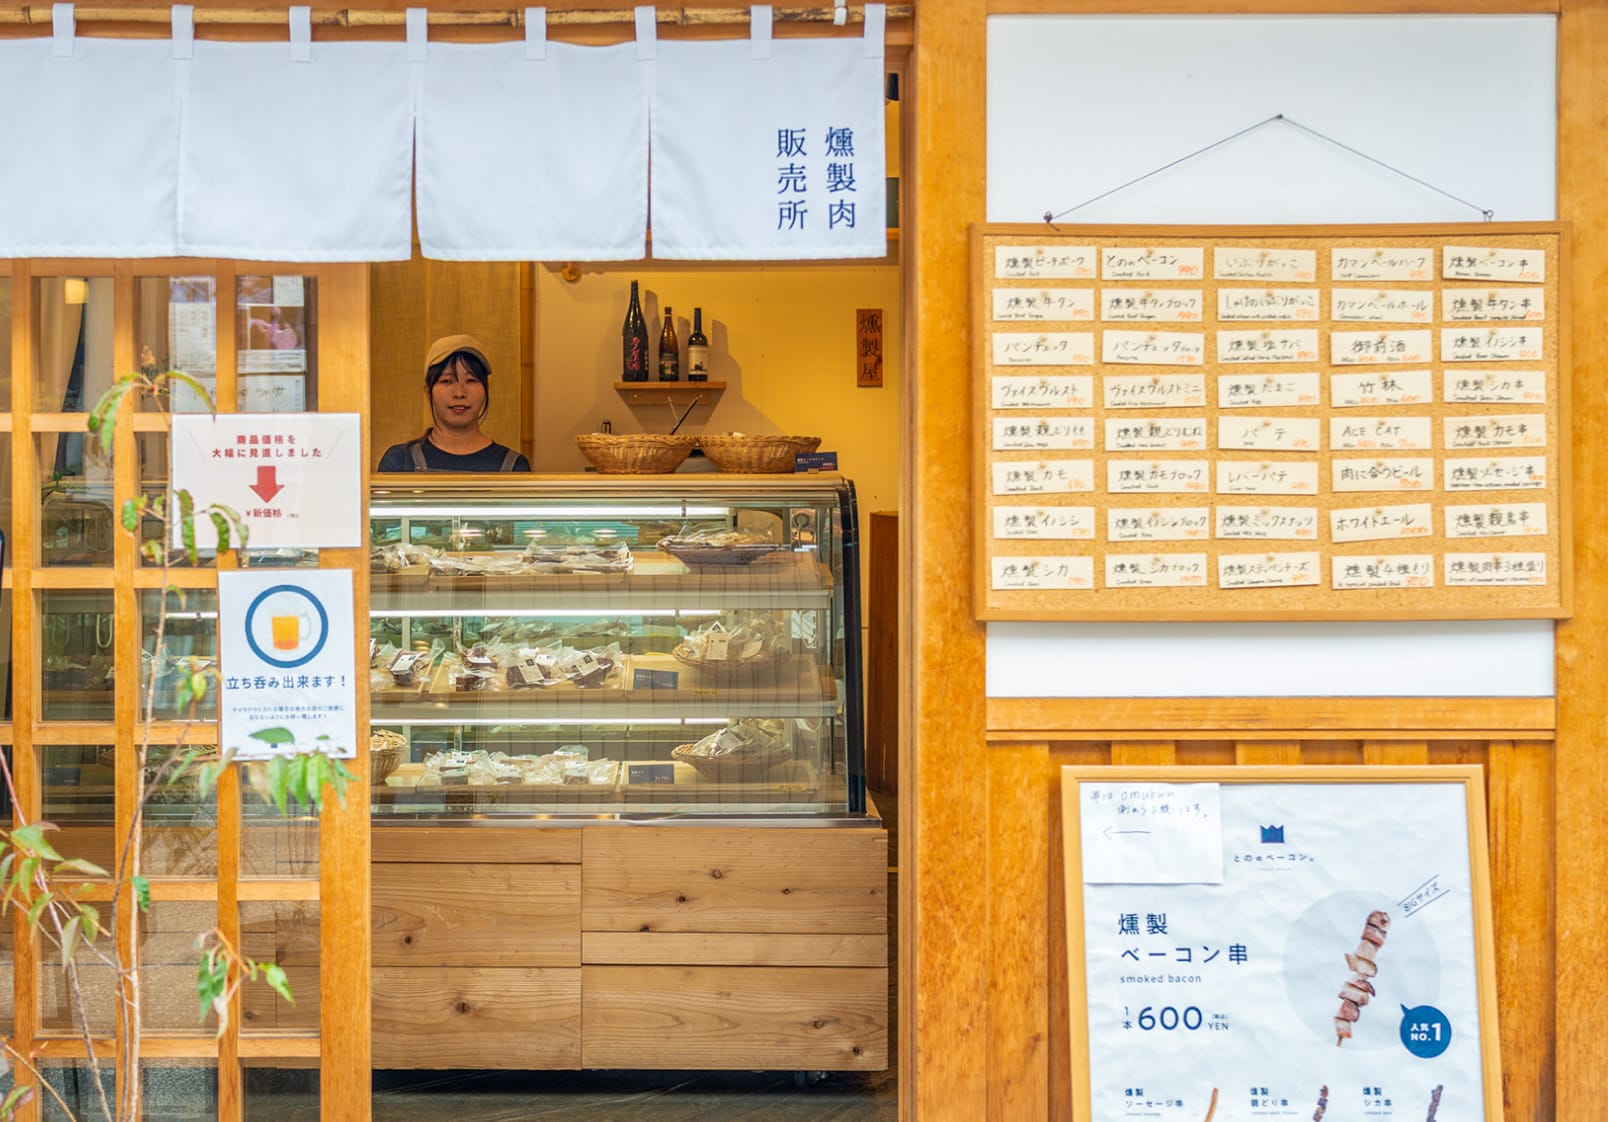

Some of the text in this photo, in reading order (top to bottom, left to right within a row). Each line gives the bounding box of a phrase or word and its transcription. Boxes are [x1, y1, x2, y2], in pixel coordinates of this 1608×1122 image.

[776, 127, 808, 230] 販売所
[825, 126, 857, 230] 燻製肉
[859, 312, 880, 381] 燻製屋
[236, 435, 296, 445] 商品価格を
[212, 448, 322, 458] 大幅に見直しました
[226, 675, 345, 690] 立ち呑み出来ます！
[1117, 913, 1169, 936] 燻製
[1121, 943, 1248, 966] ベーコン串
[1120, 974, 1202, 984] smoked bacon
[1138, 1006, 1203, 1031] 600
[1207, 1022, 1229, 1031] YEN
[1410, 1023, 1430, 1032] 人気
